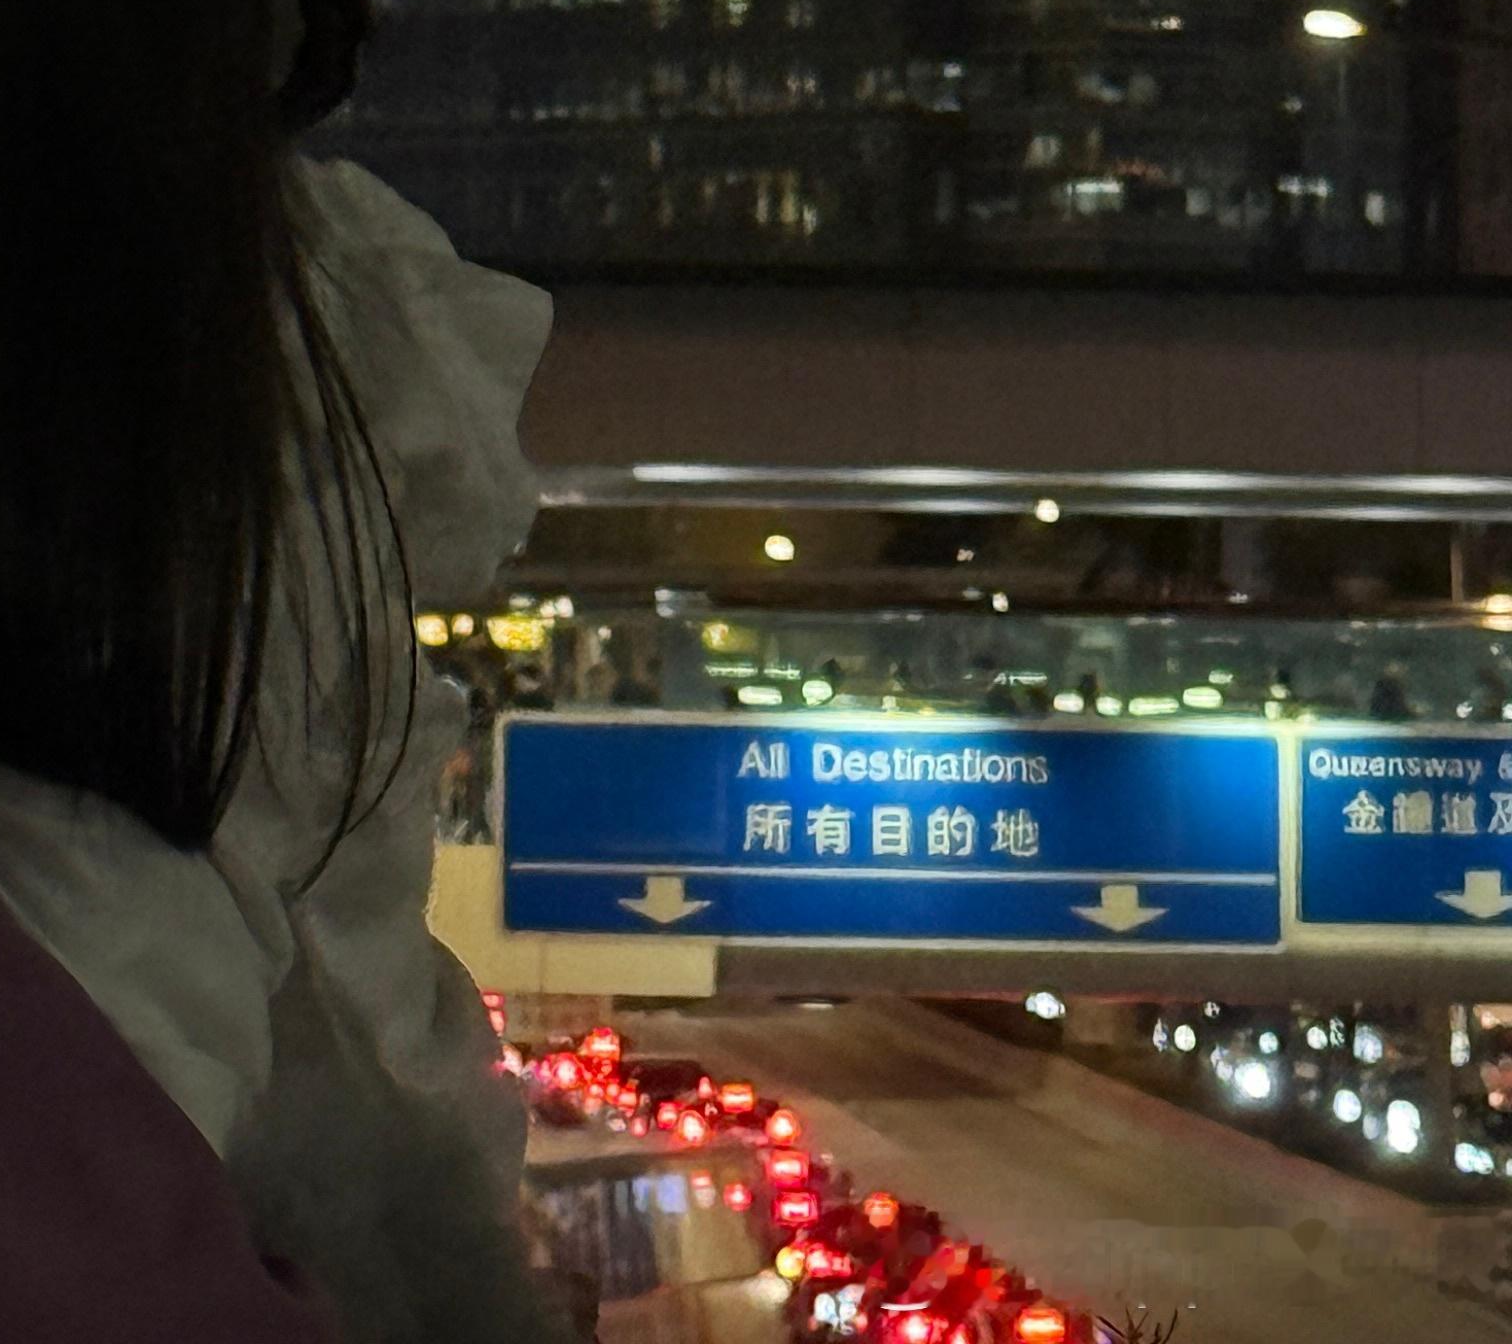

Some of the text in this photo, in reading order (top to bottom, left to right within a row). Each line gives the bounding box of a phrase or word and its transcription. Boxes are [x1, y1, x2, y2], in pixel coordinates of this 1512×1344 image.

[737, 741, 1049, 783] All Destinations
[1308, 748, 1482, 784] Queensway
[743, 802, 1040, 857] 所有目的地
